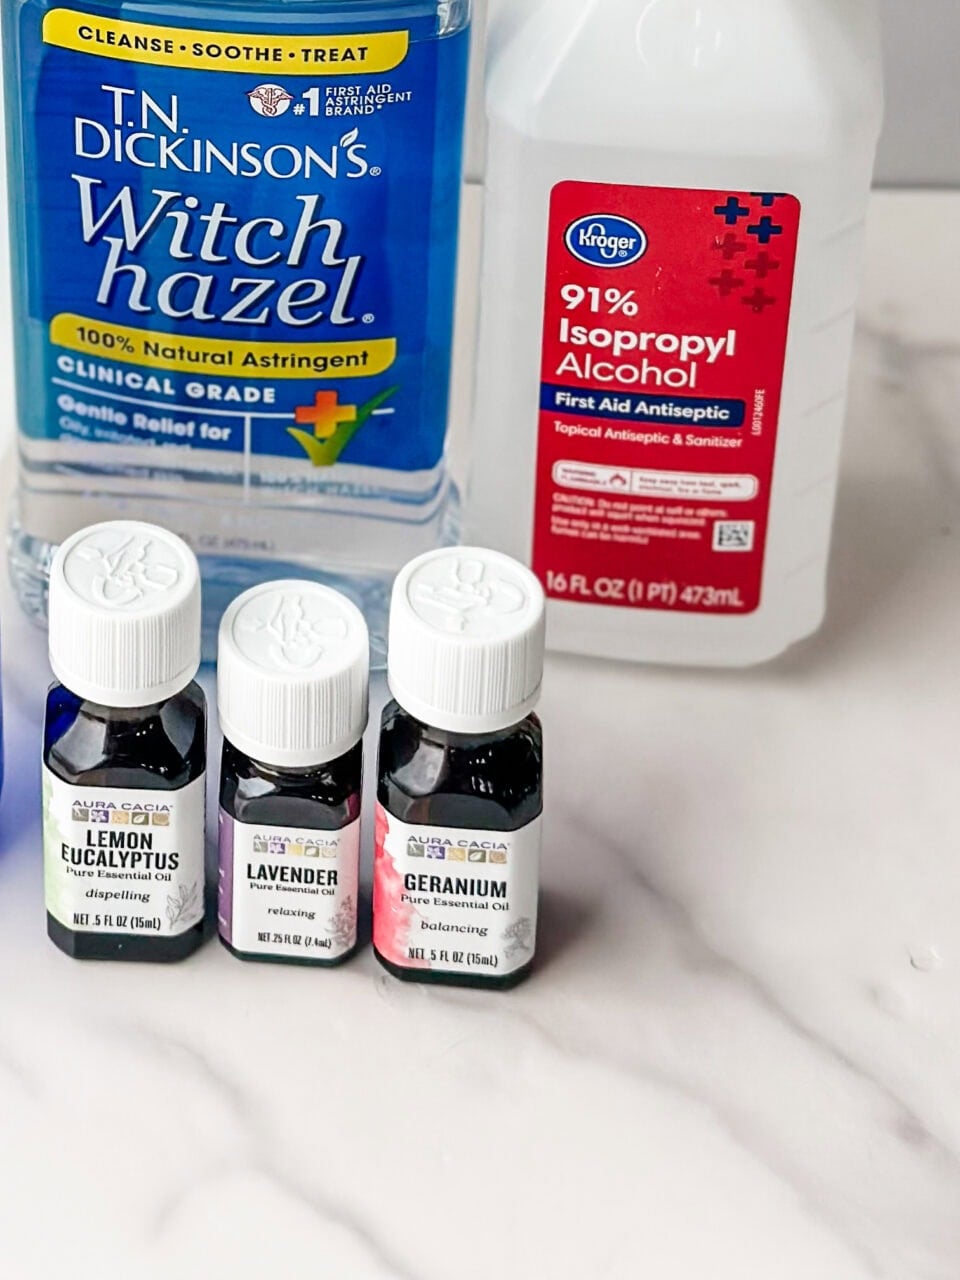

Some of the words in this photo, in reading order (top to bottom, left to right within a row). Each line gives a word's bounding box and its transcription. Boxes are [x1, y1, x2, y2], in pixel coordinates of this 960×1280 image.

[78, 26, 173, 53] CLEANSE
[192, 43, 283, 62] SOOTHE
[302, 47, 368, 62] TREAT
[101, 84, 189, 134] T.N.
[293, 87, 320, 116] #1
[325, 86, 362, 96] FIRST
[367, 84, 392, 94] AID
[325, 91, 413, 107] ASTRINGENT
[72, 174, 345, 266] Witch
[560, 284, 639, 316] 91%
[77, 327, 135, 353] 100%
[143, 341, 233, 365] Natural
[241, 350, 368, 372] Astringent
[559, 317, 736, 364] Isopropyl
[57, 355, 176, 396] CLINICAL
[185, 382, 276, 403] GRADE
[555, 352, 697, 388] Alcohol
[57, 393, 127, 426] Gentle
[133, 413, 196, 438] Relief
[200, 423, 231, 441] for
[555, 392, 595, 410] First
[598, 397, 631, 413] Aid
[634, 400, 730, 422] Antiseptic
[554, 421, 602, 438] Topical
[604, 427, 670, 445] Antiseptic
[672, 433, 683, 446] &
[685, 433, 742, 448] Sanitizer
[546, 571, 567, 593] 16
[570, 574, 591, 596] FL
[593, 577, 625, 599] OZ
[647, 582, 677, 607] PT)
[680, 588, 744, 607] 473mL
[72, 799, 117, 810] AURA
[121, 802, 171, 812] CACIA
[86, 829, 153, 850] LEMON
[253, 834, 291, 844] AURA
[295, 837, 338, 846] CACIA
[407, 835, 453, 846] AURA
[457, 839, 508, 850] CACIA
[61, 842, 179, 871] EUCALYPTUS
[66, 866, 95, 878] Pure
[97, 870, 152, 881] Essential
[154, 872, 172, 882] Oil
[247, 863, 338, 886] LAVENDER
[404, 873, 507, 898] GERANIUM
[85, 888, 151, 903] dispelling
[249, 882, 273, 892] Pure
[276, 884, 319, 895] Essential
[321, 888, 335, 896] Oil
[267, 907, 316, 920] relaxing
[401, 894, 430, 905] Pure
[433, 898, 489, 910] Essential
[492, 902, 509, 911] Oil
[73, 913, 90, 926] NET
[104, 915, 114, 927] FL
[116, 916, 128, 927] OZ
[130, 917, 161, 930] (15mL)
[420, 920, 488, 937] balancing
[258, 932, 272, 942] NET
[292, 935, 302, 945] OZ
[408, 947, 425, 960] NET
[440, 950, 449, 962] FL
[452, 951, 464, 963] OZ
[466, 952, 498, 967] (15mL)
